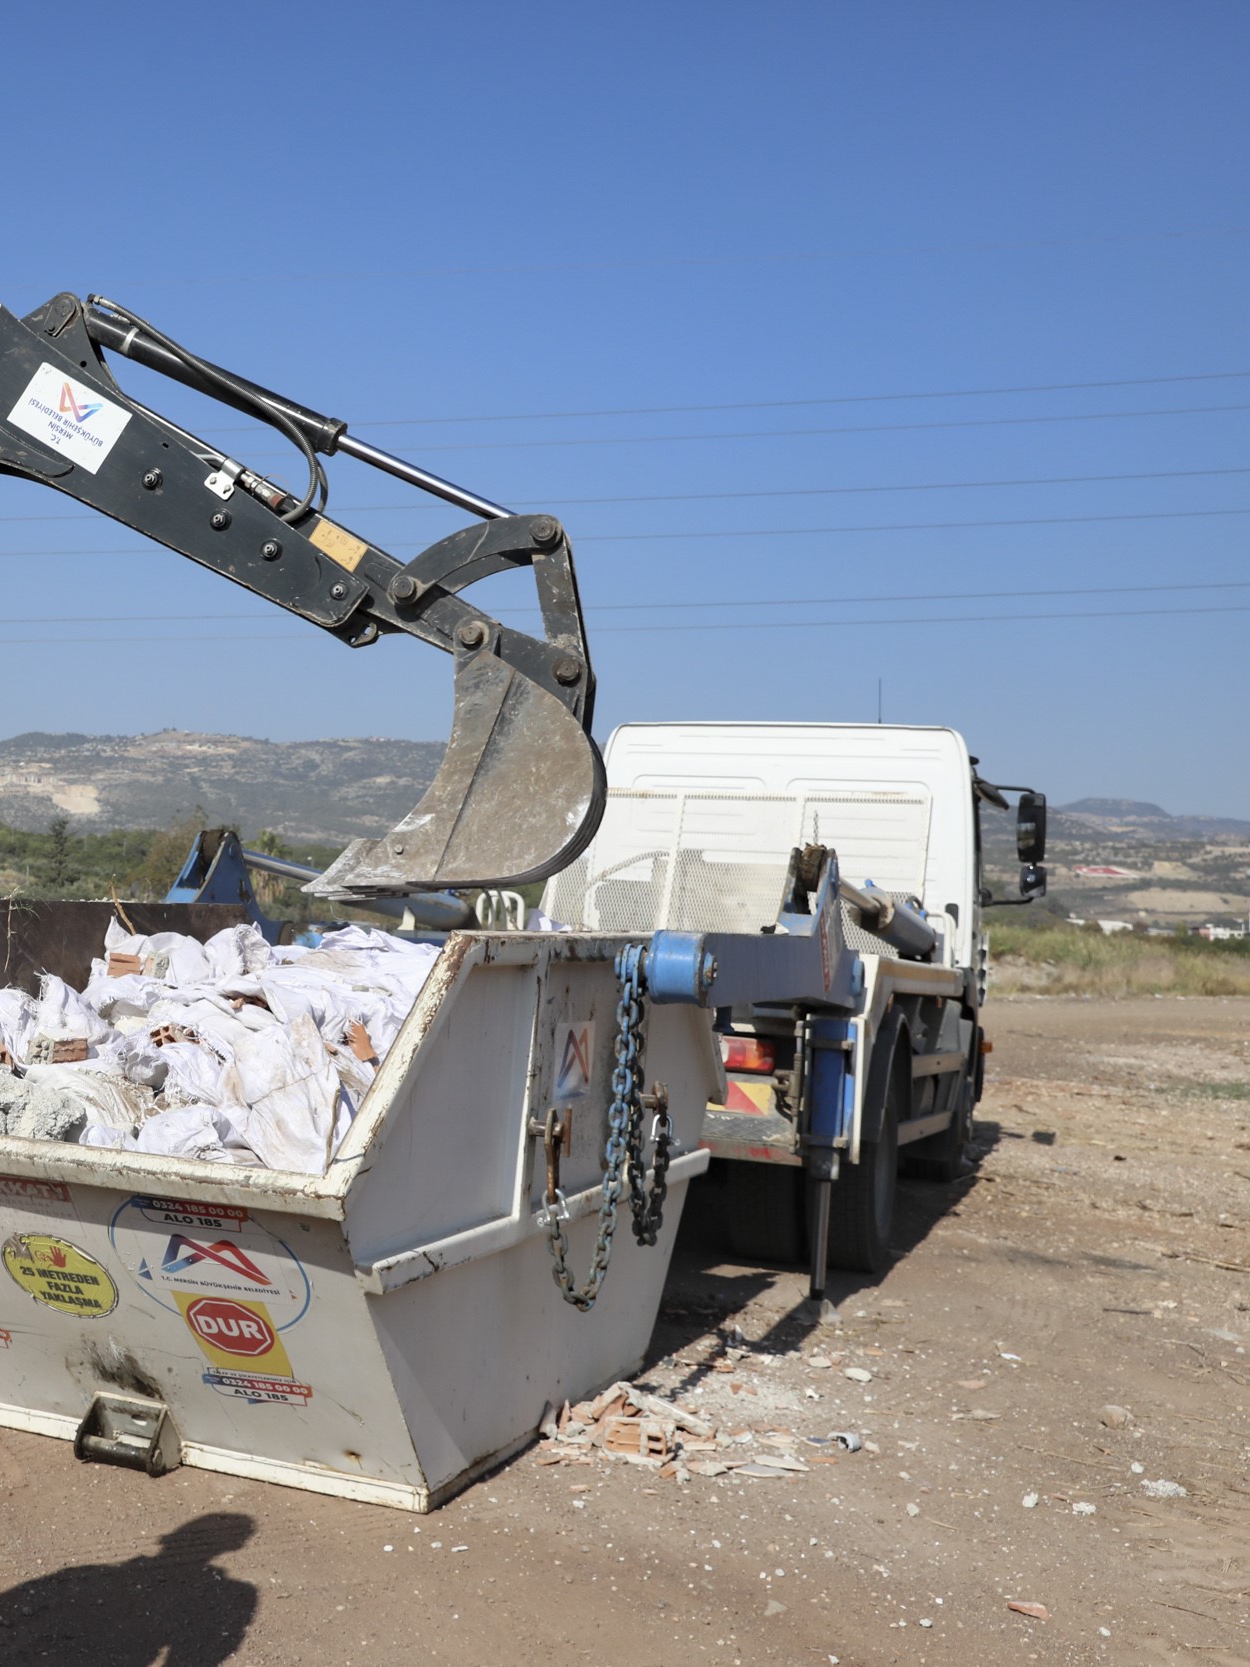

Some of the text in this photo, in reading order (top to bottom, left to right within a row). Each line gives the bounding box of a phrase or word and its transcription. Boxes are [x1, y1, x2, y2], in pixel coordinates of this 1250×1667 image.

[28, 397, 104, 447] BÜYÜKŞEHİR BELEDİYESİ
[48, 421, 73, 440] MERSİN
[152, 1200, 183, 1212] 0324
[185, 1203, 208, 1215] 185
[210, 1206, 225, 1216] 00
[227, 1209, 244, 1218] 00
[164, 1213, 223, 1228] ALO 185
[19, 1265, 100, 1286] 25 METREDEN
[46, 1281, 84, 1296] FAZLA
[174, 1277, 199, 1286] MERSİN
[200, 1280, 242, 1292] BÜYÜKŞEHİR
[244, 1286, 280, 1296] BELEDİYESİ
[39, 1289, 103, 1310] YAKLAŞMA
[196, 1314, 265, 1340] DUR
[222, 1377, 251, 1388] 0324
[252, 1381, 273, 1391] 185
[274, 1384, 291, 1393] 00
[292, 1386, 309, 1395] 00
[234, 1388, 289, 1402] ALO 185
